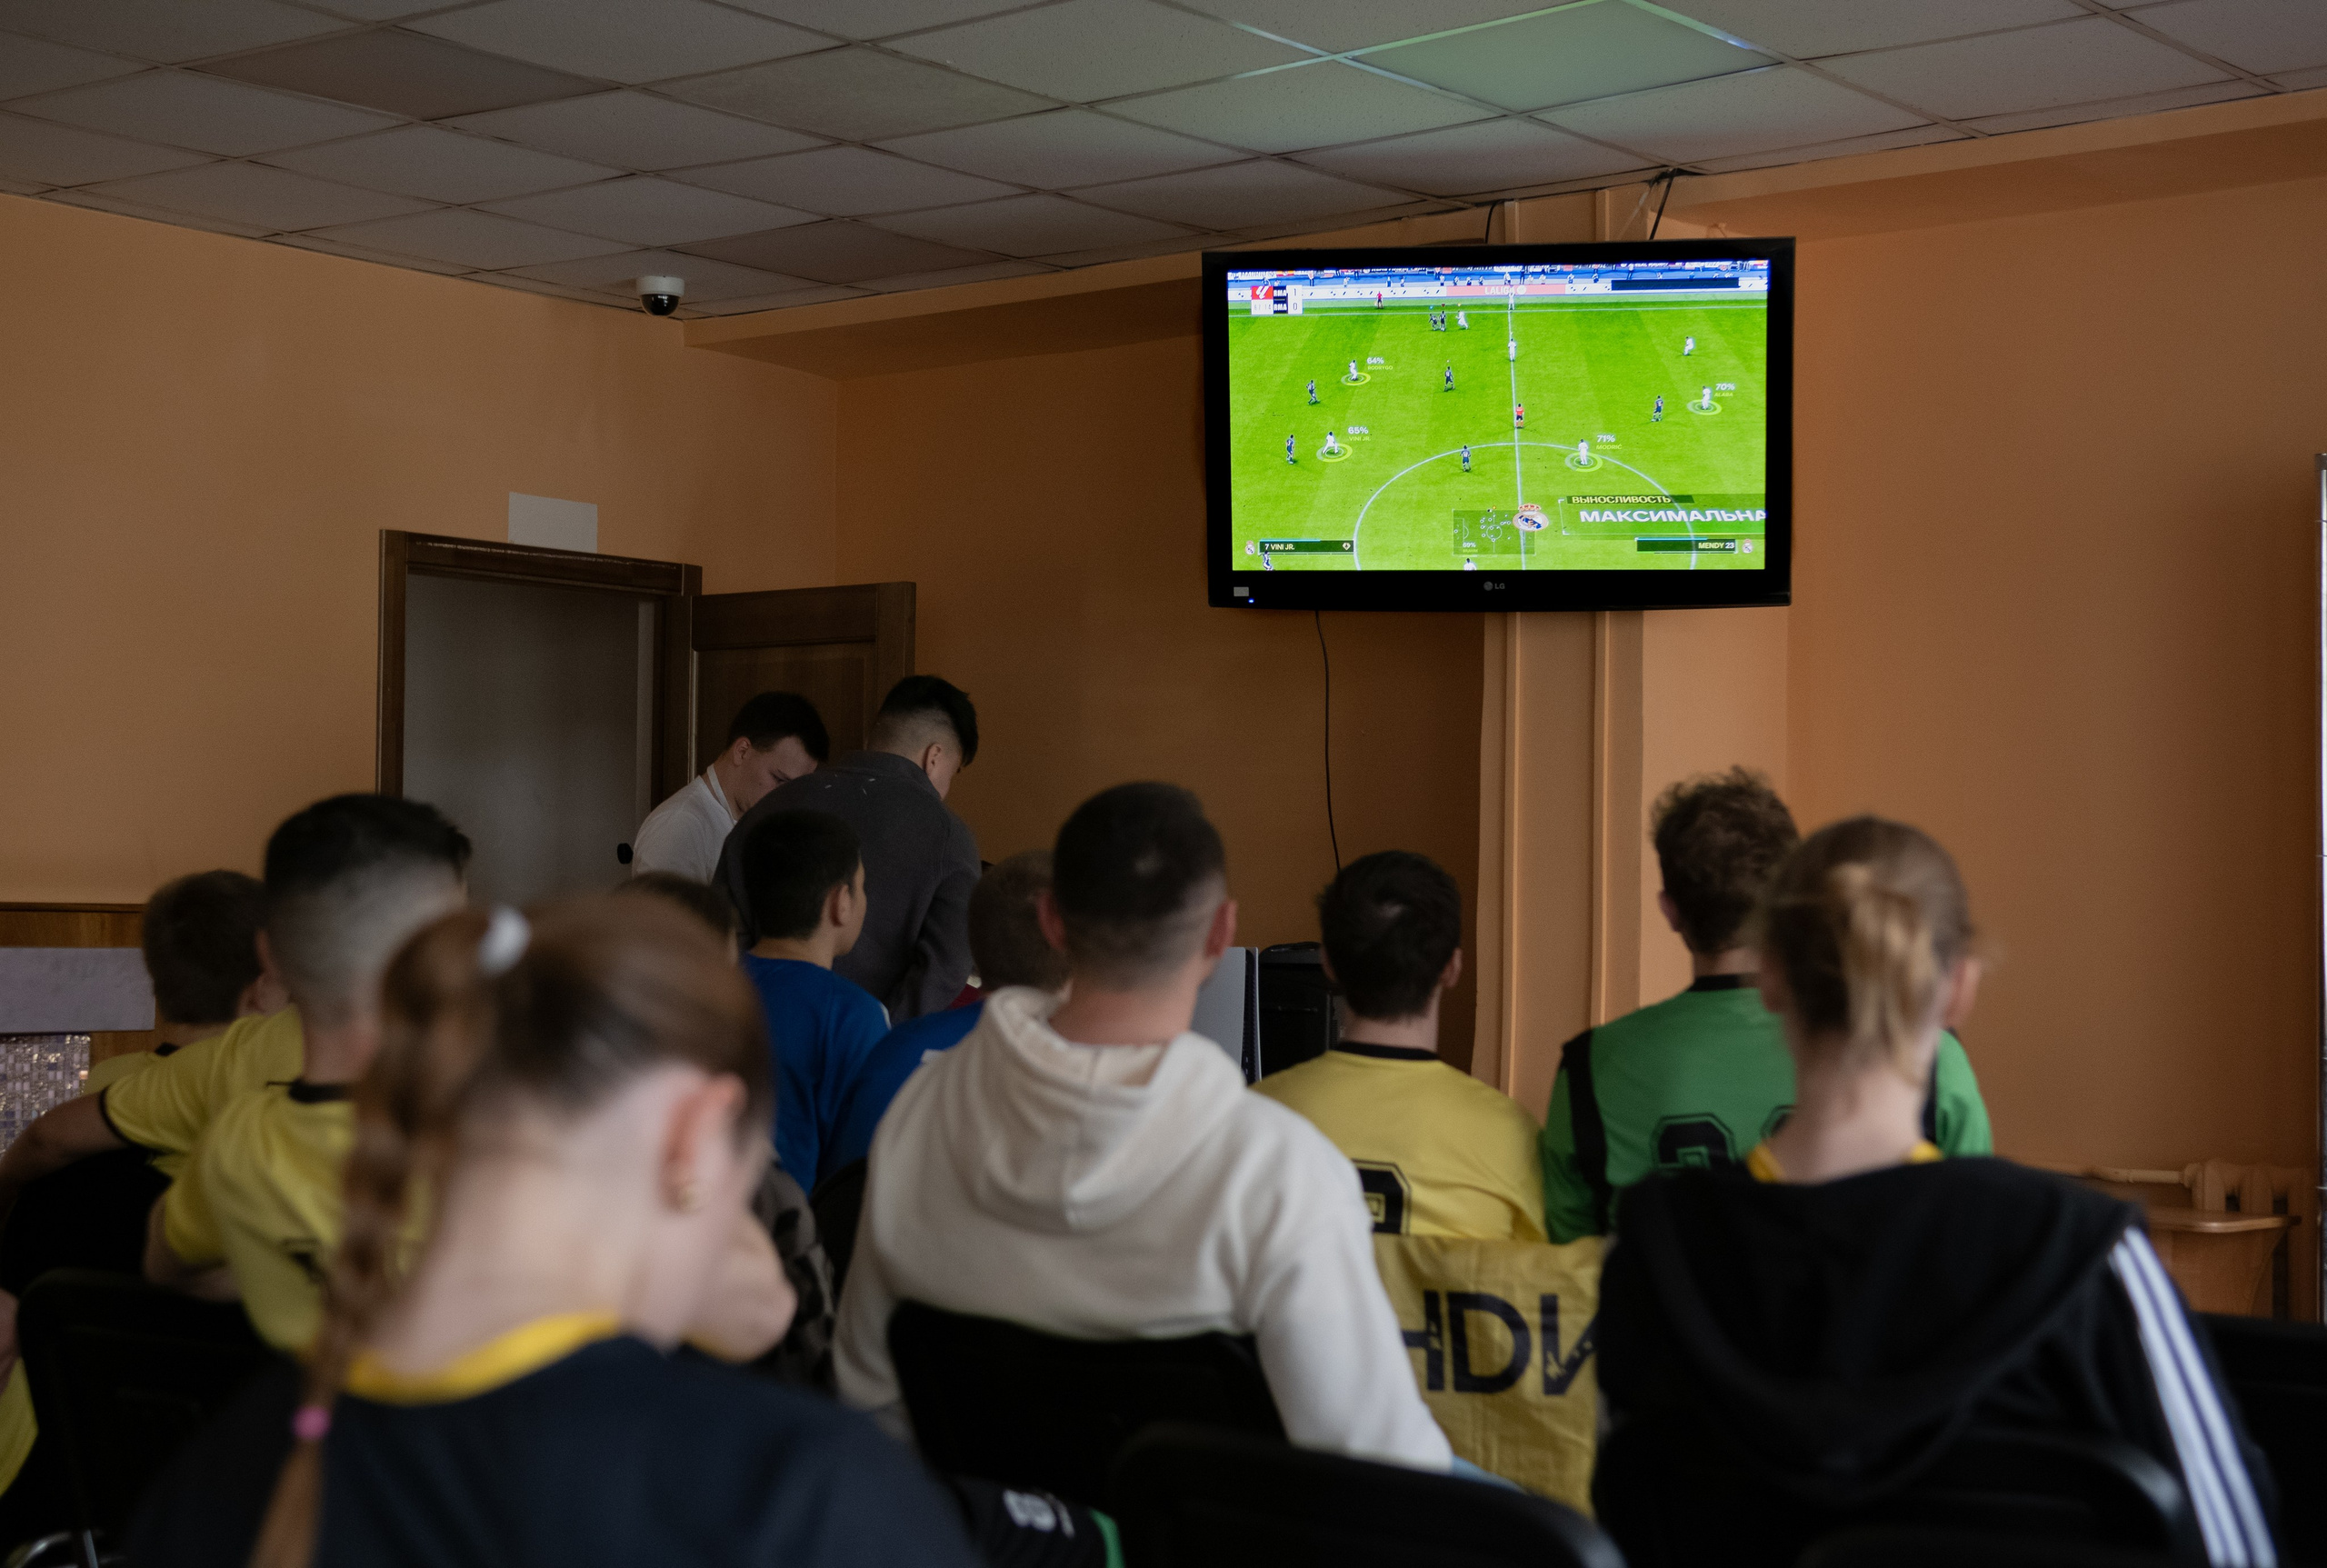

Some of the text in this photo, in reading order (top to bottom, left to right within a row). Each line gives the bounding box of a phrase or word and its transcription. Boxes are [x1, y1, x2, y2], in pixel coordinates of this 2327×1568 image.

[1484, 285, 1515, 295] LALIGA
[1715, 383, 1735, 391] 70%
[1347, 426, 1369, 434] 65%
[1596, 434, 1616, 443] 71%
[1572, 495, 1672, 504] ВЫНОСЛИВОСТЬ
